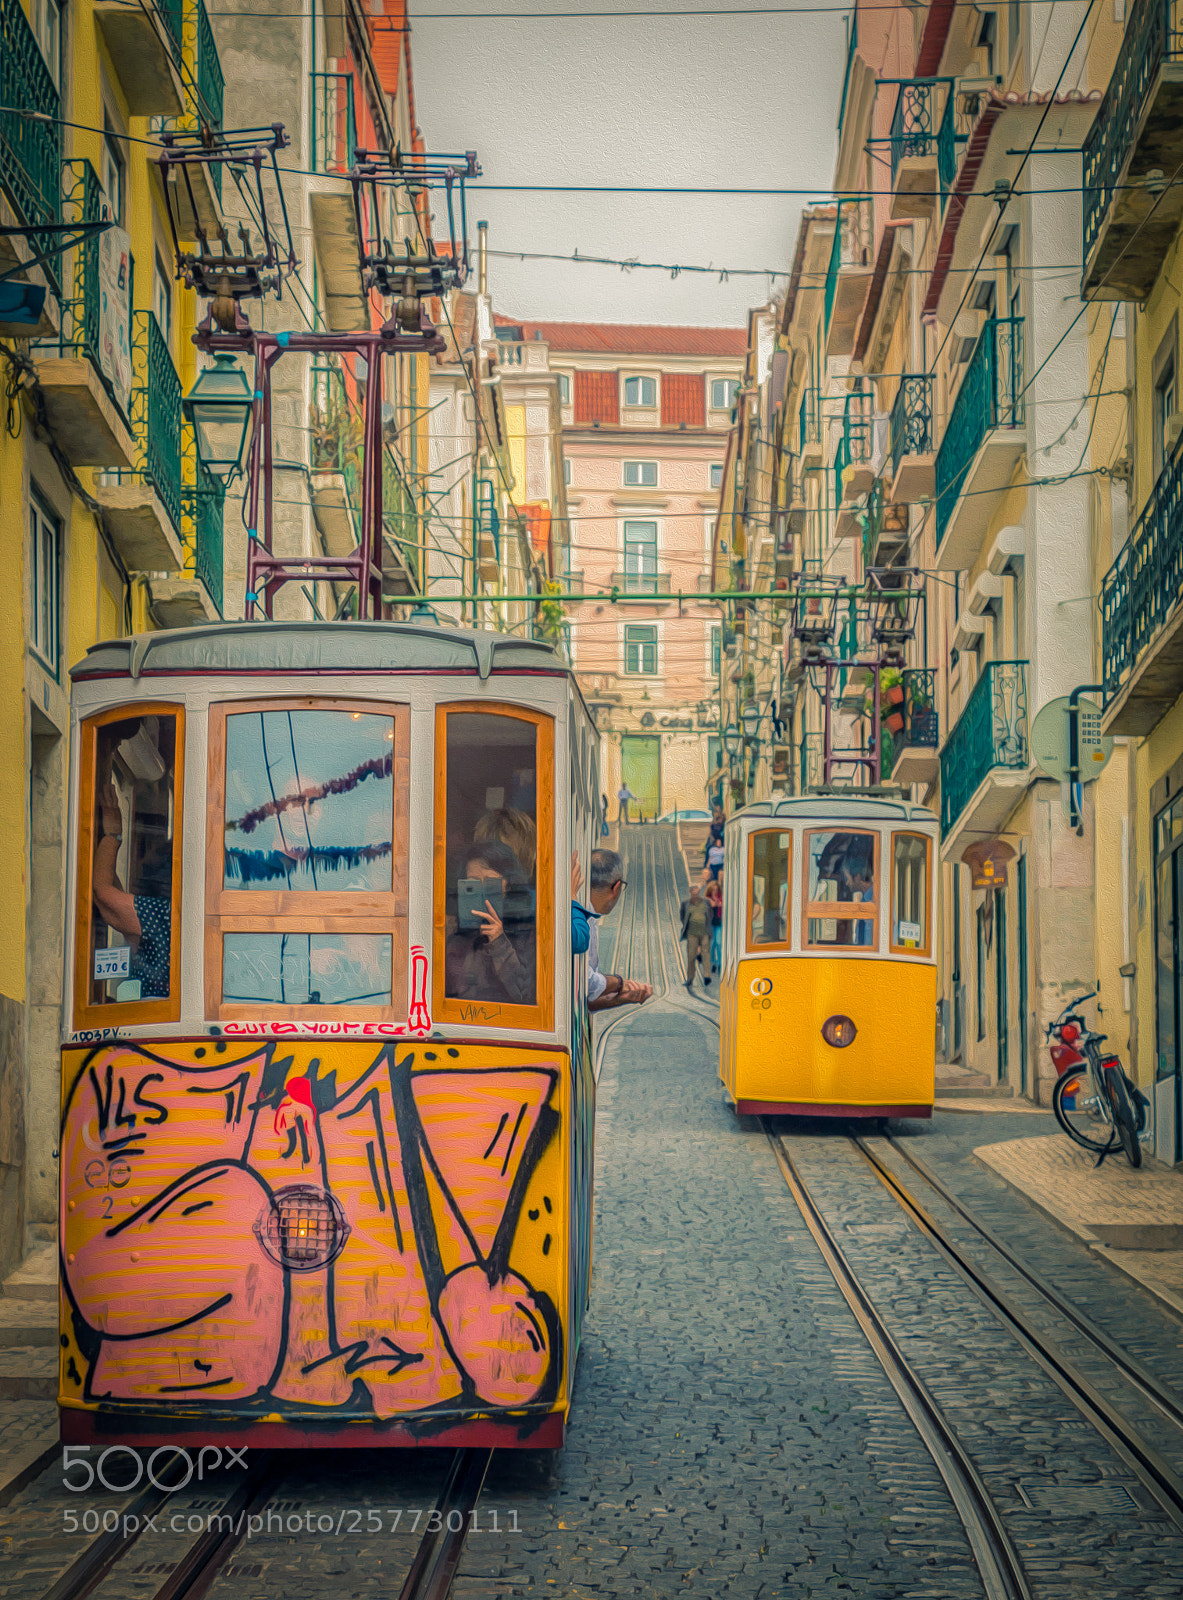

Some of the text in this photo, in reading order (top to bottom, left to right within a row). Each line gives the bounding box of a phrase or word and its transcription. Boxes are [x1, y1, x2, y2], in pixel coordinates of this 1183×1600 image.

[96, 961, 128, 974] 3.70 €
[101, 1196, 114, 1219] 2
